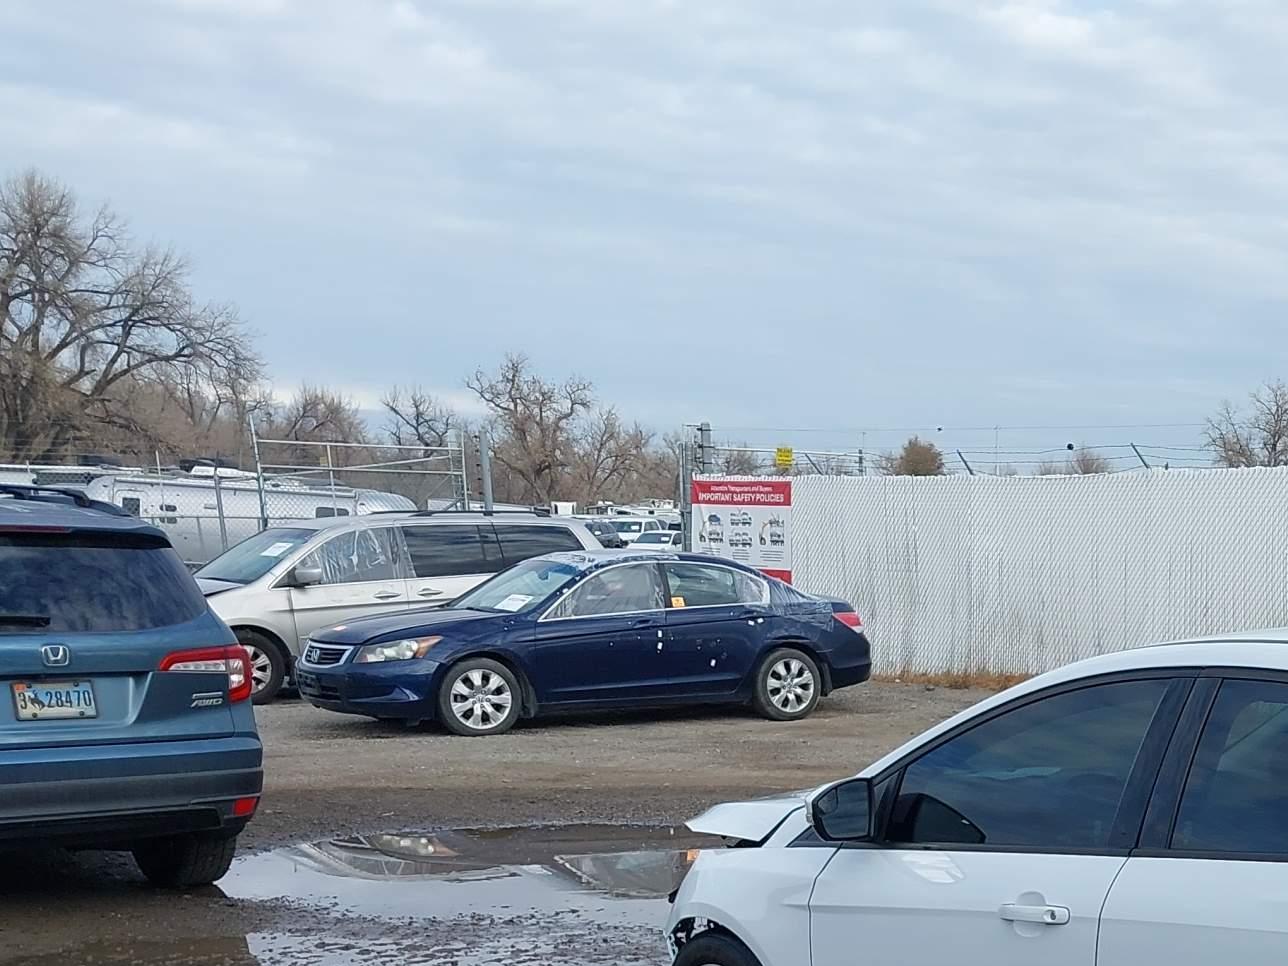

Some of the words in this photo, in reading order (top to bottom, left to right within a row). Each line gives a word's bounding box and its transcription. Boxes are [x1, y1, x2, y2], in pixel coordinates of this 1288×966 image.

[698, 492, 732, 501] IMPORTANT
[732, 493, 756, 502] SAFETY
[756, 493, 785, 502] POLICIES
[18, 692, 27, 709] 3
[45, 690, 91, 708] 28470
